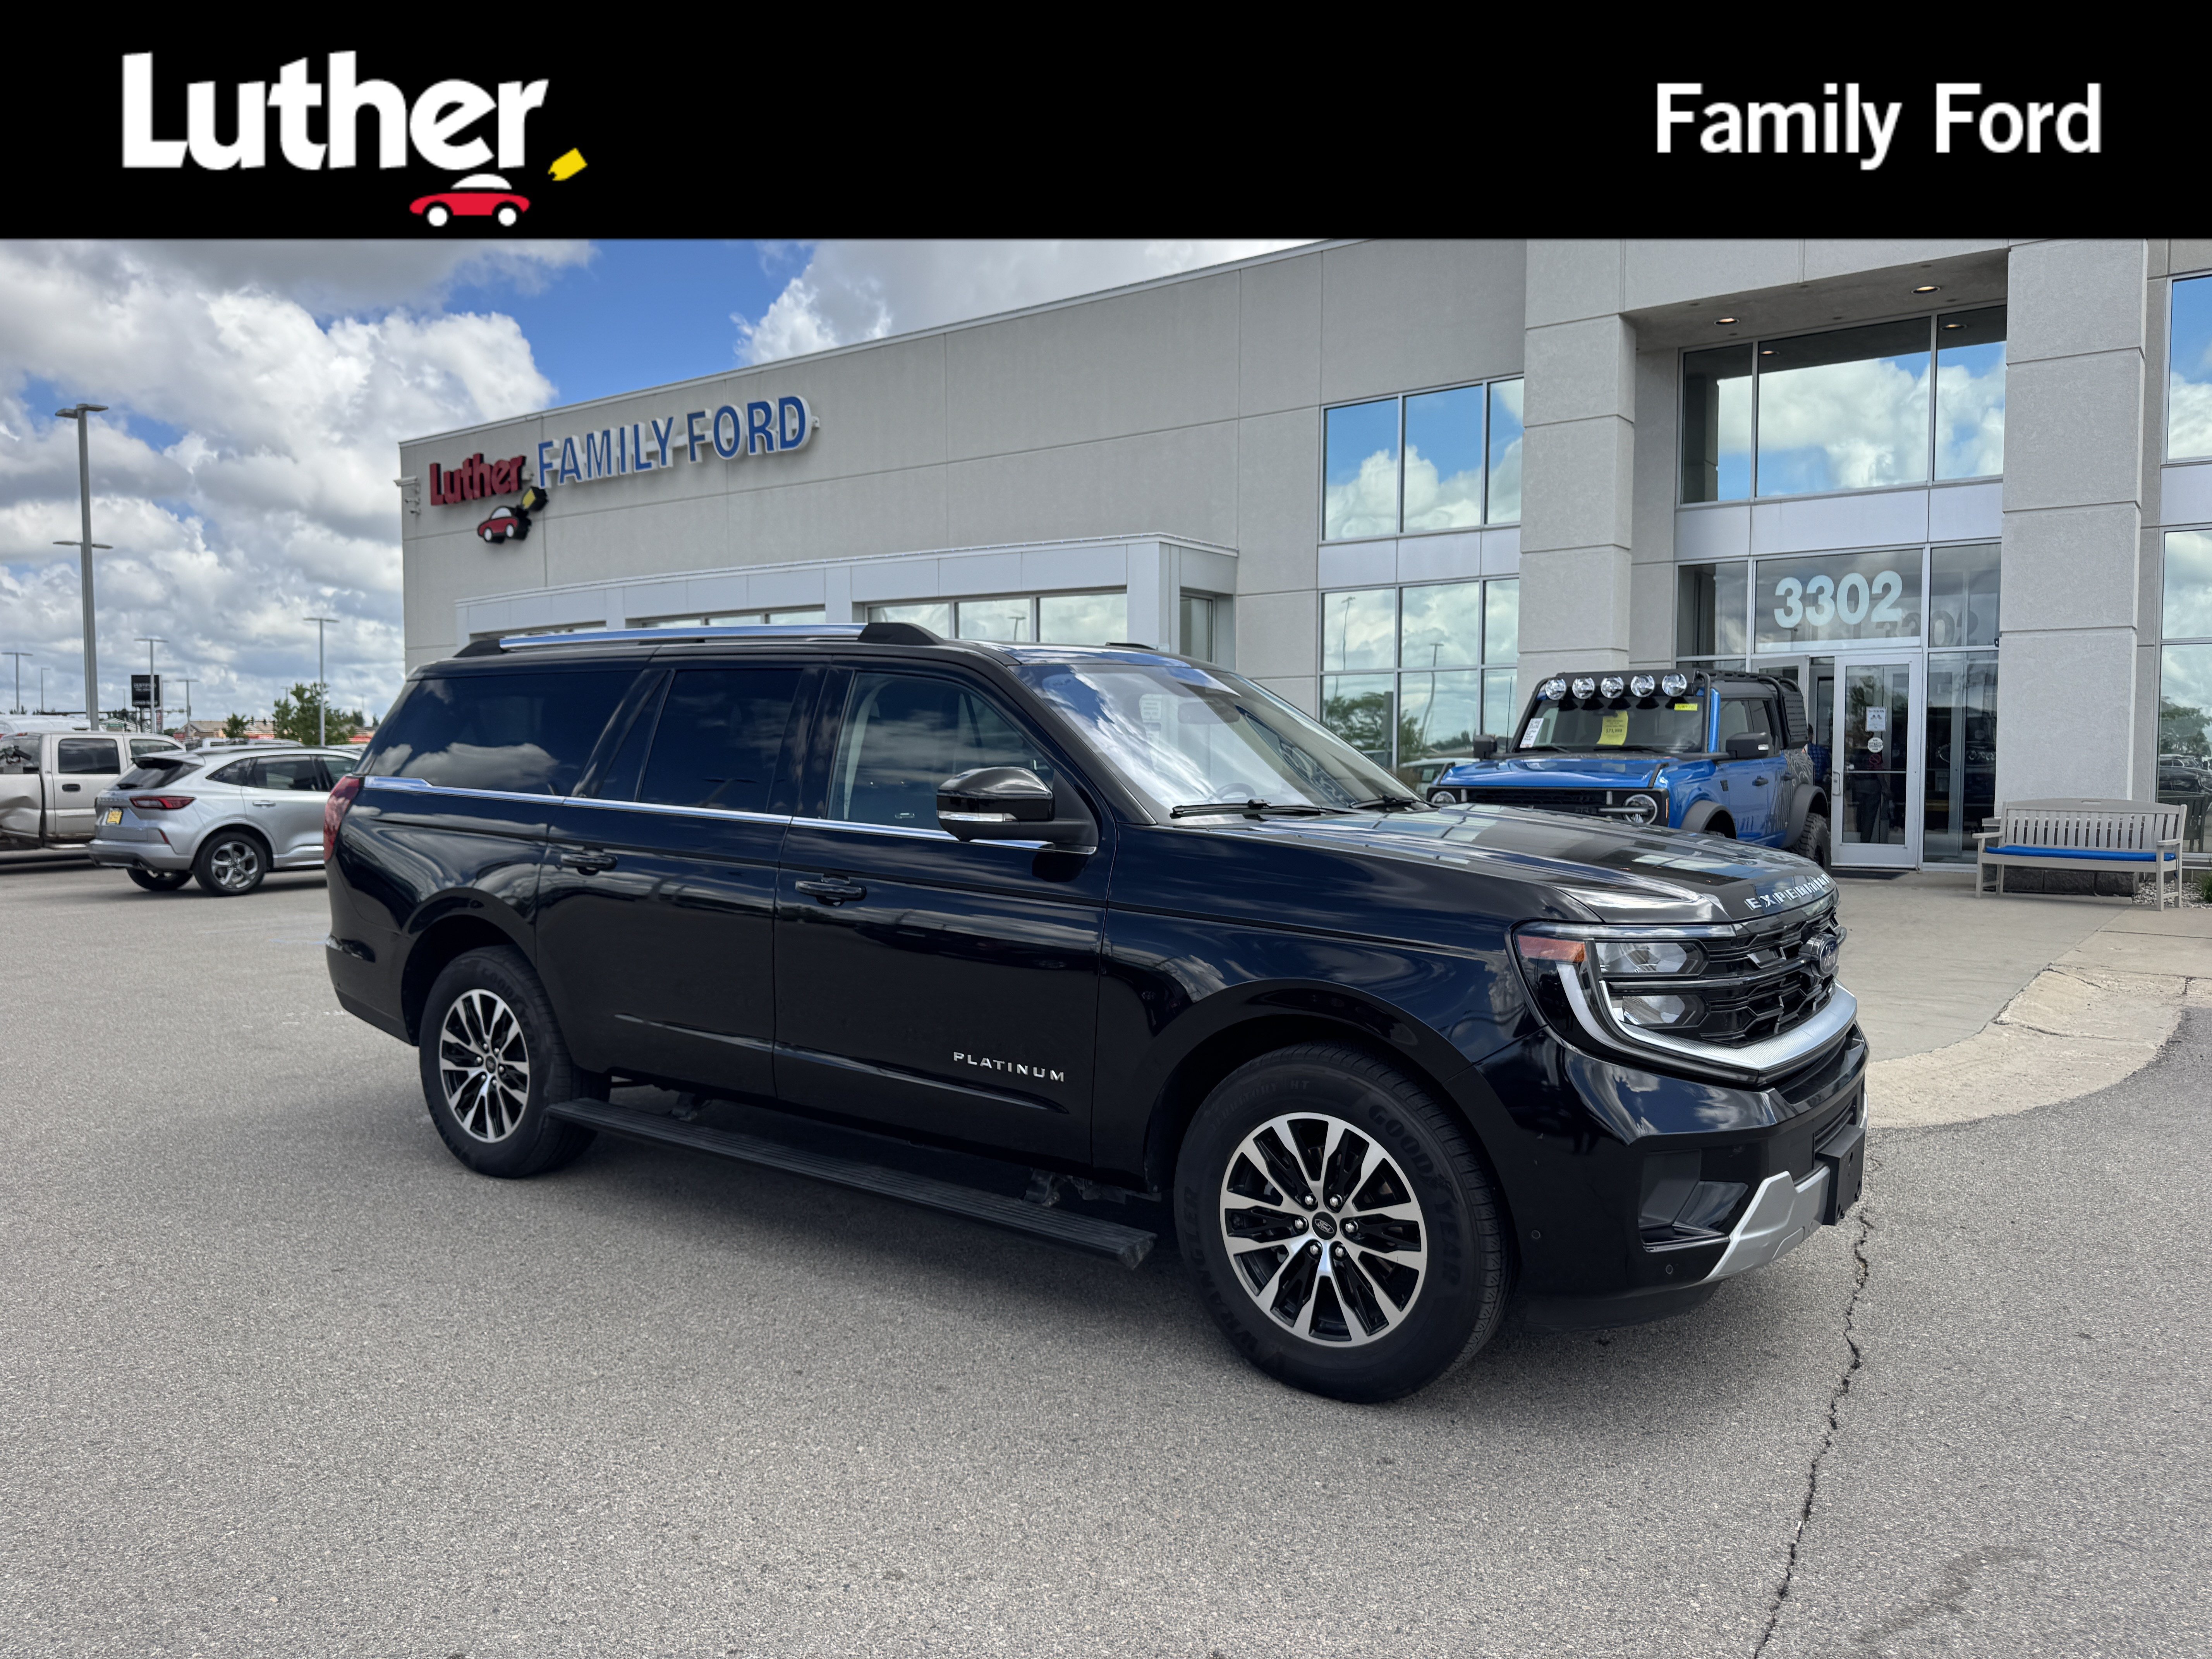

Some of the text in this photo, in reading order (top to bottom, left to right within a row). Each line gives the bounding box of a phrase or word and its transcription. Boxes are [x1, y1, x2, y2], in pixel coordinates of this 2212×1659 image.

[429, 395, 810, 506] Luther FAMILY FORD
[1774, 570, 1902, 628] 3302
[953, 1051, 1065, 1082] PLATINUM
